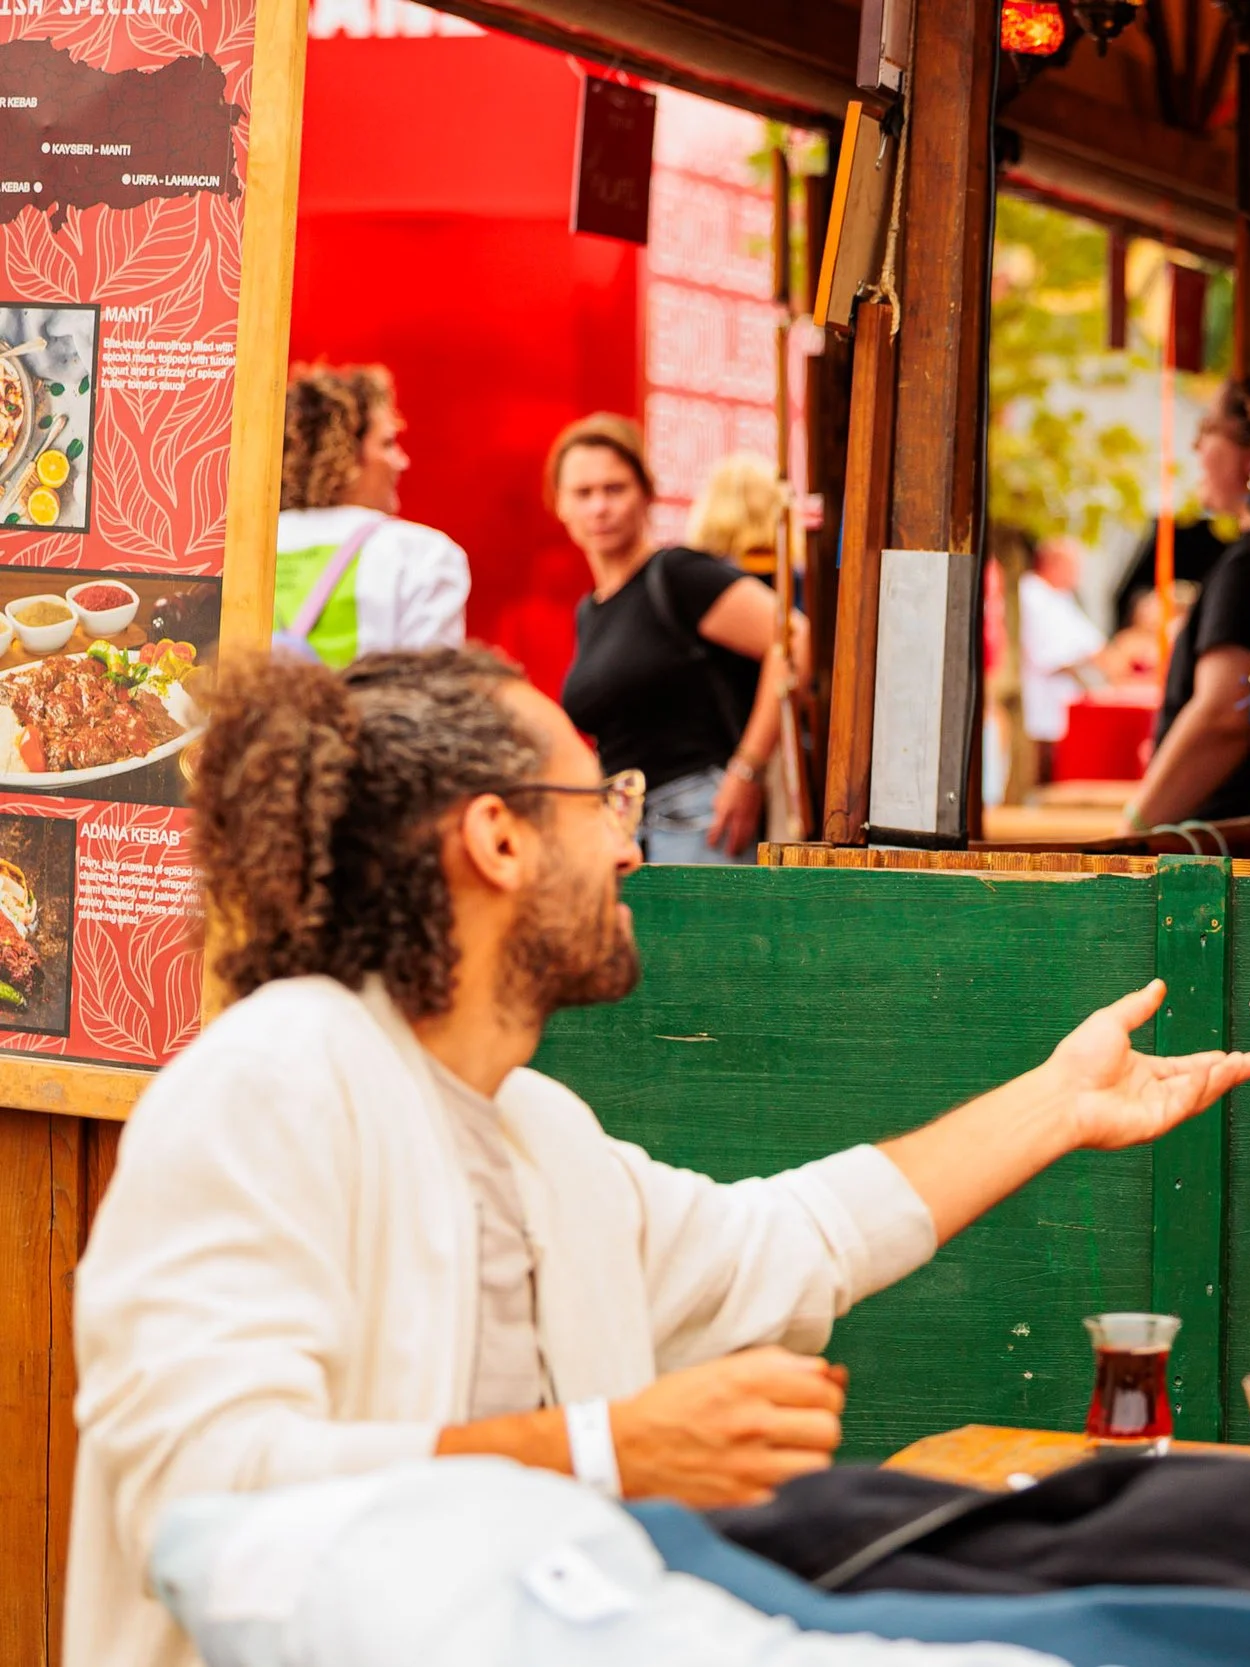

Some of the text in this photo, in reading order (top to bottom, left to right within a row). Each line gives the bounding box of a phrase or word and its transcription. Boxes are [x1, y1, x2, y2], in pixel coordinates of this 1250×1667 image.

[59, 0, 184, 15] SPECIALS
[7, 97, 38, 108] KEBAB
[52, 143, 93, 155] KAYSERI
[100, 144, 131, 156] MANTI
[1, 181, 30, 193] KEBAB
[132, 175, 159, 186] URFA
[165, 176, 220, 187] LAHMACUN
[105, 306, 153, 323] MANTI
[147, 340, 192, 353] dumplings
[194, 341, 214, 351] filled
[215, 342, 233, 352] with
[102, 352, 130, 364] spiced
[158, 354, 189, 366] topped
[191, 355, 208, 365] with
[101, 366, 226, 380] yogurt and a drizzle of spiced
[101, 379, 186, 392] butter tomato sauce
[80, 822, 180, 846] ADANA KEBAB
[121, 861, 153, 874] skewers
[154, 864, 164, 874] of
[164, 865, 192, 878] spiced
[79, 870, 108, 882] charred
[109, 873, 118, 883] to
[160, 878, 198, 891] wrapped
[79, 885, 101, 895] warm
[138, 889, 153, 899] and
[155, 890, 181, 902] paired
[183, 893, 202, 904] with
[79, 897, 104, 909] smoky
[105, 898, 134, 911] roasted
[135, 902, 167, 915] peppers
[167, 905, 184, 916] and
[79, 909, 117, 924] refreshing
